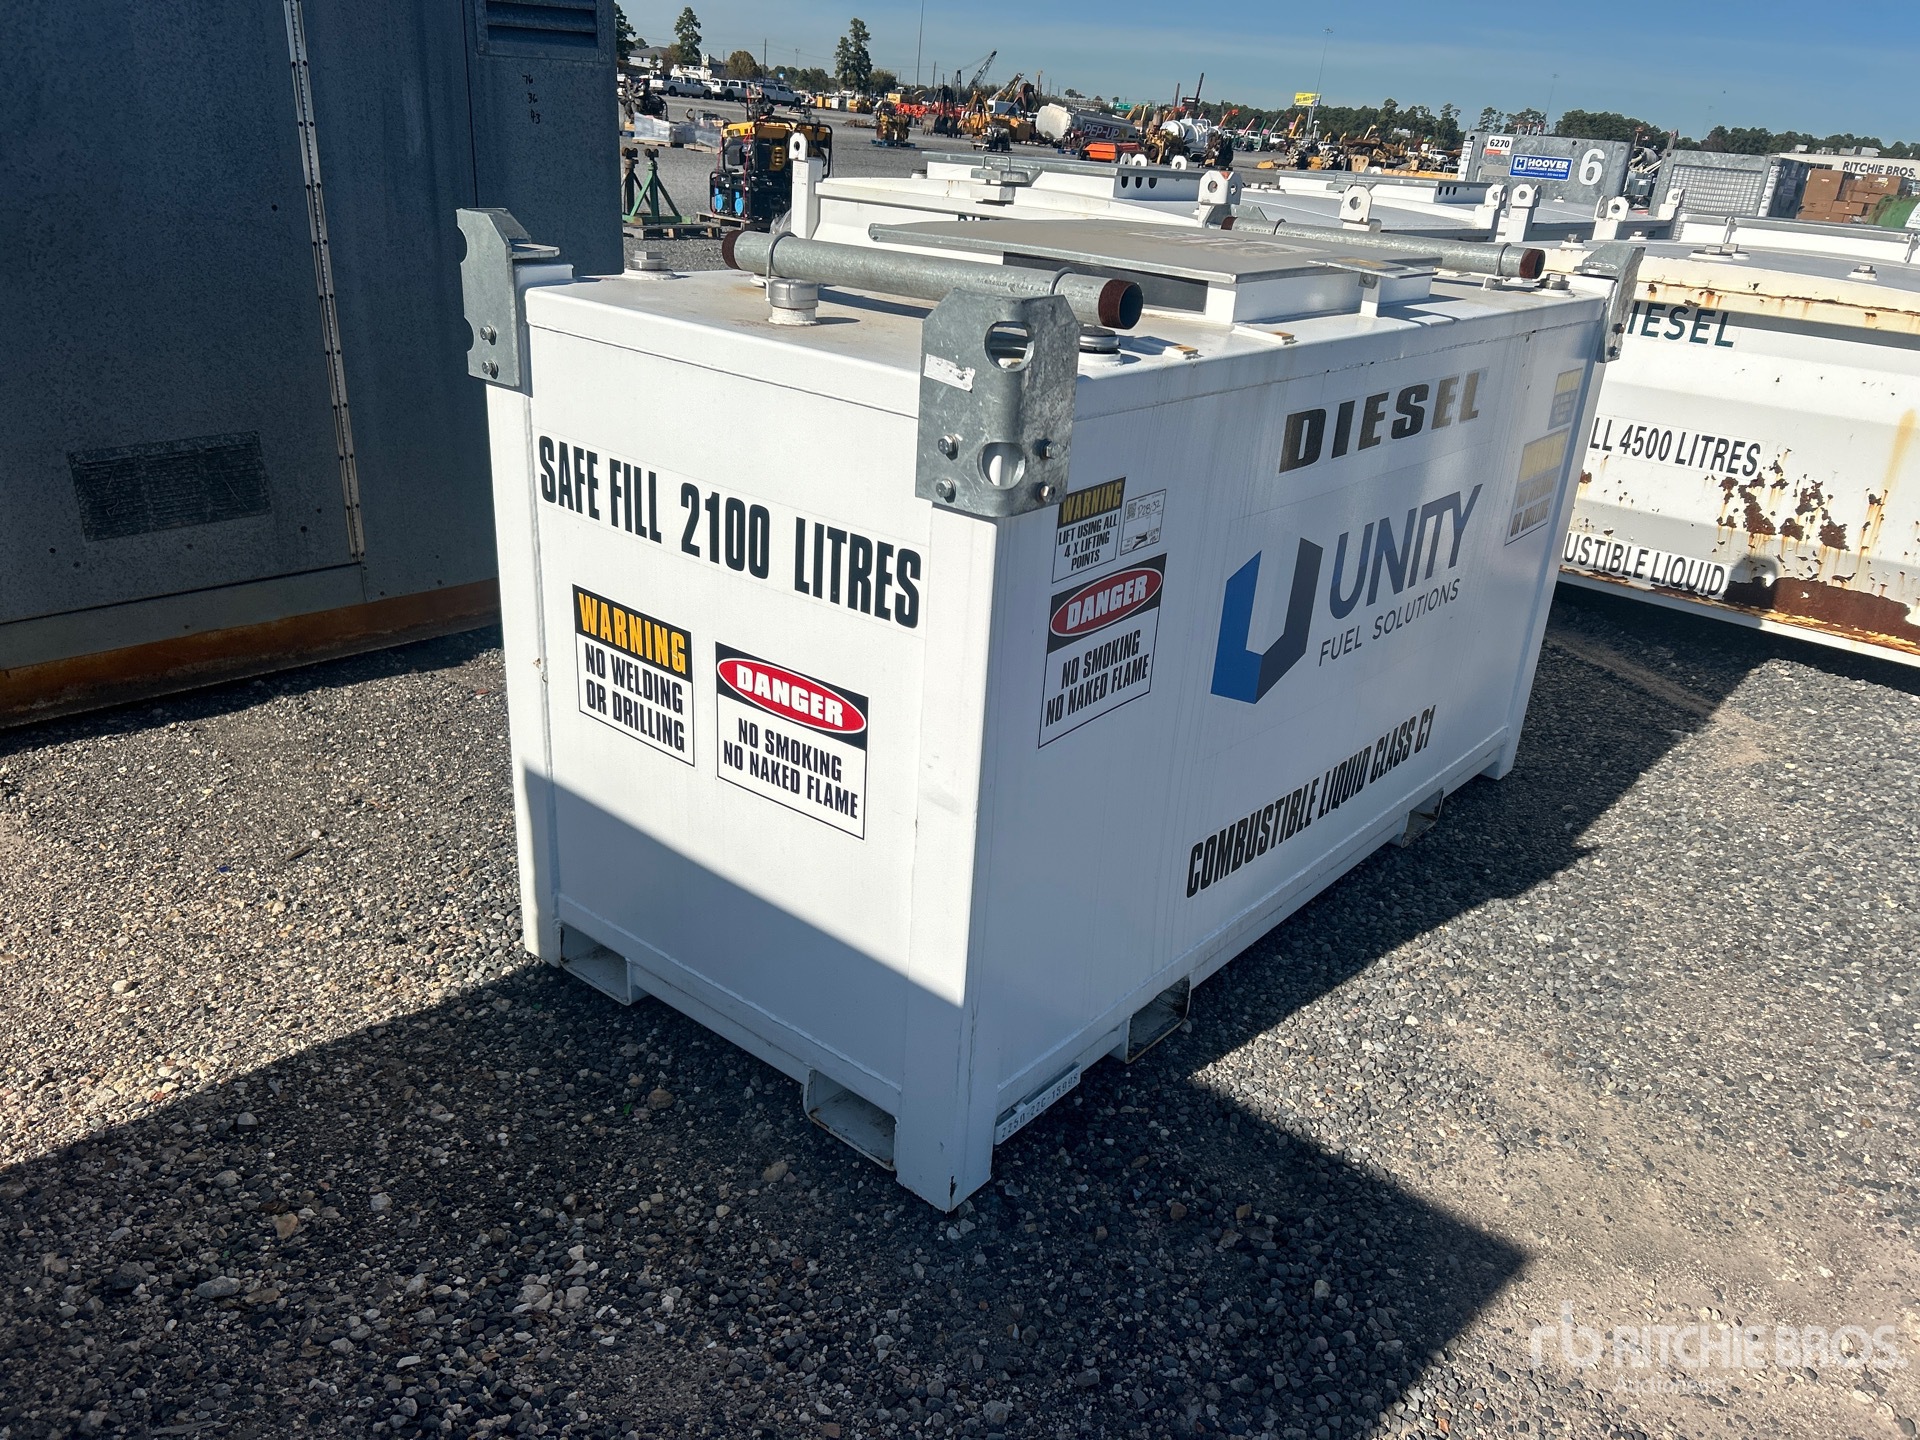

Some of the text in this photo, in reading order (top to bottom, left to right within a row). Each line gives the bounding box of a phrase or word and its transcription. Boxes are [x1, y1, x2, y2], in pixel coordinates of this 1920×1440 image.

[1083, 123, 1120, 140] PEP-UP
[1489, 138, 1510, 148] 6270
[1527, 158, 1569, 170] HOOVER
[1578, 148, 1605, 186] 6
[1842, 161, 1916, 178] RITCHIE BROS.
[1628, 302, 1734, 347] IESEL
[1278, 371, 1480, 474] DIESEL
[1589, 417, 1761, 477] LL 4500 LITRES
[538, 435, 922, 629] SAFE FILL 2100 LITRES
[1058, 513, 1118, 546] LIFT USING ALL
[1061, 481, 1122, 525] WARNING
[1064, 543, 1071, 558] 4
[1072, 541, 1079, 555] X
[1080, 530, 1110, 553] LIFTING
[1071, 549, 1100, 571] POINTS
[1329, 483, 1483, 620] UNITY
[1564, 532, 1725, 596] USTIBLE LIQUID
[578, 590, 687, 675] WARNING
[1066, 574, 1147, 631] DANGER
[1319, 578, 1460, 667] FUEL SOLUTIONS
[584, 643, 683, 715] NO WELDING
[1045, 653, 1150, 727] NO NAKED FLAME
[1061, 629, 1141, 690] NO SMOKING
[586, 680, 685, 753] OR DRILLING
[735, 664, 844, 728] DANGER
[723, 740, 858, 820] NO NAKED FLAME
[738, 717, 842, 783] NO SMOKING
[1186, 704, 1437, 899] COMBUSTIBLE LIQUID CLASS C1
